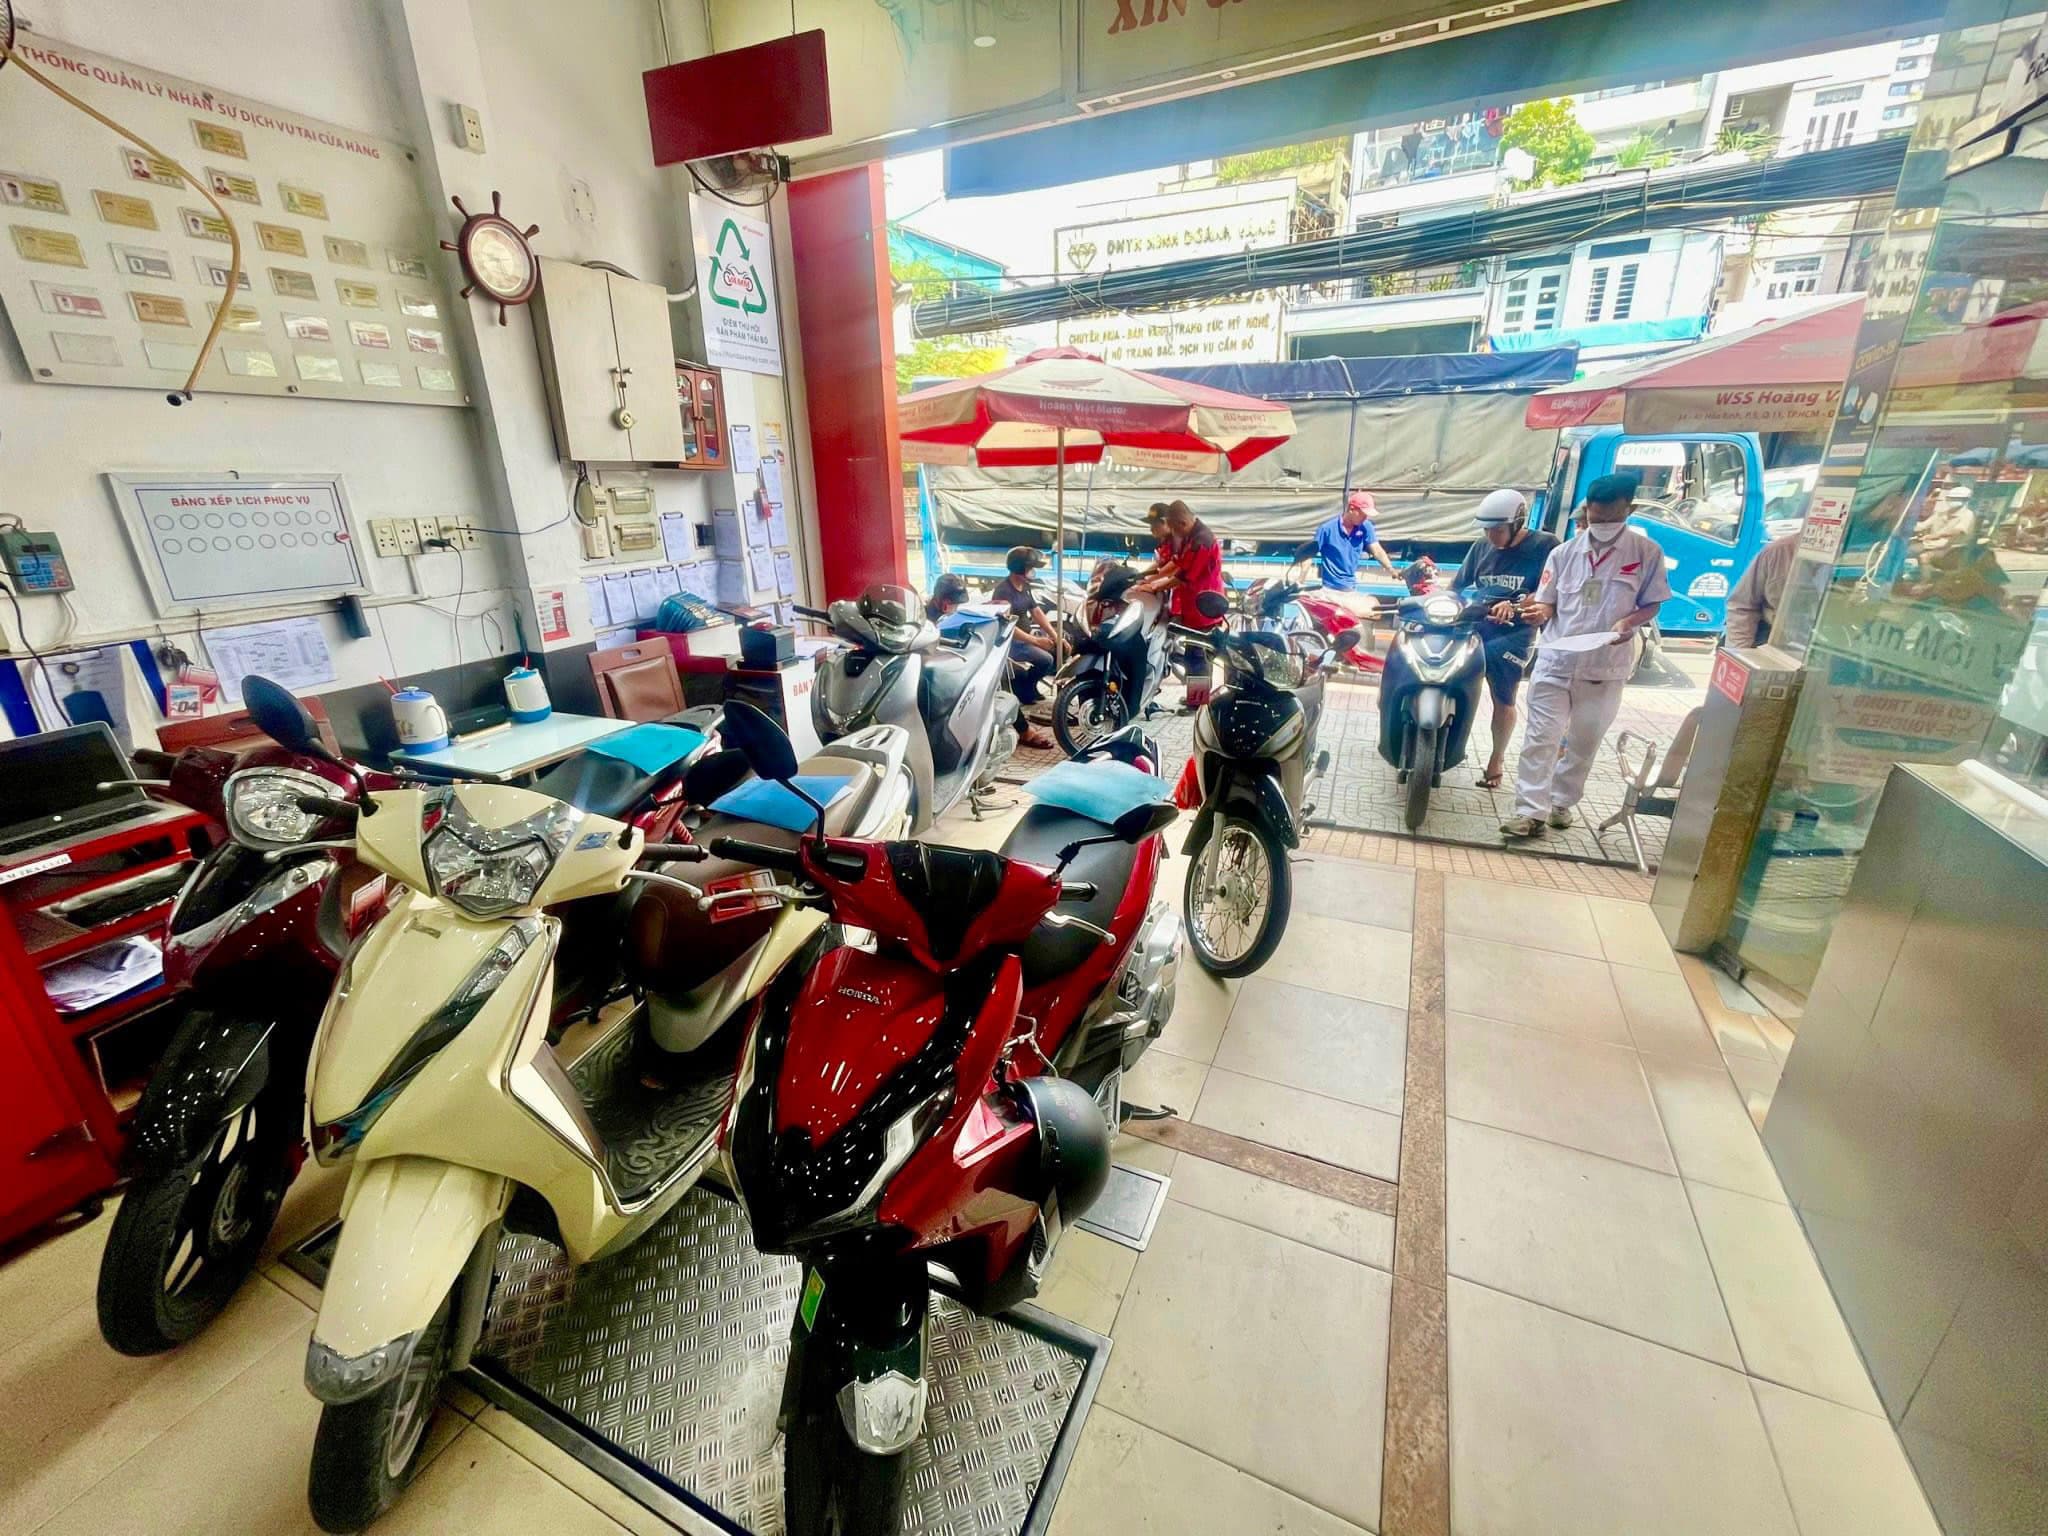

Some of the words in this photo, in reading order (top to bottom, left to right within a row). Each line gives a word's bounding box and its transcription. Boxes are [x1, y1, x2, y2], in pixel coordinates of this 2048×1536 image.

[93, 67, 144, 92] QUẢN
[1716, 391, 1754, 406] WSS
[1757, 390, 1819, 407] Hoàng
[177, 700, 198, 713] 04
[838, 986, 880, 1005] HONDA
